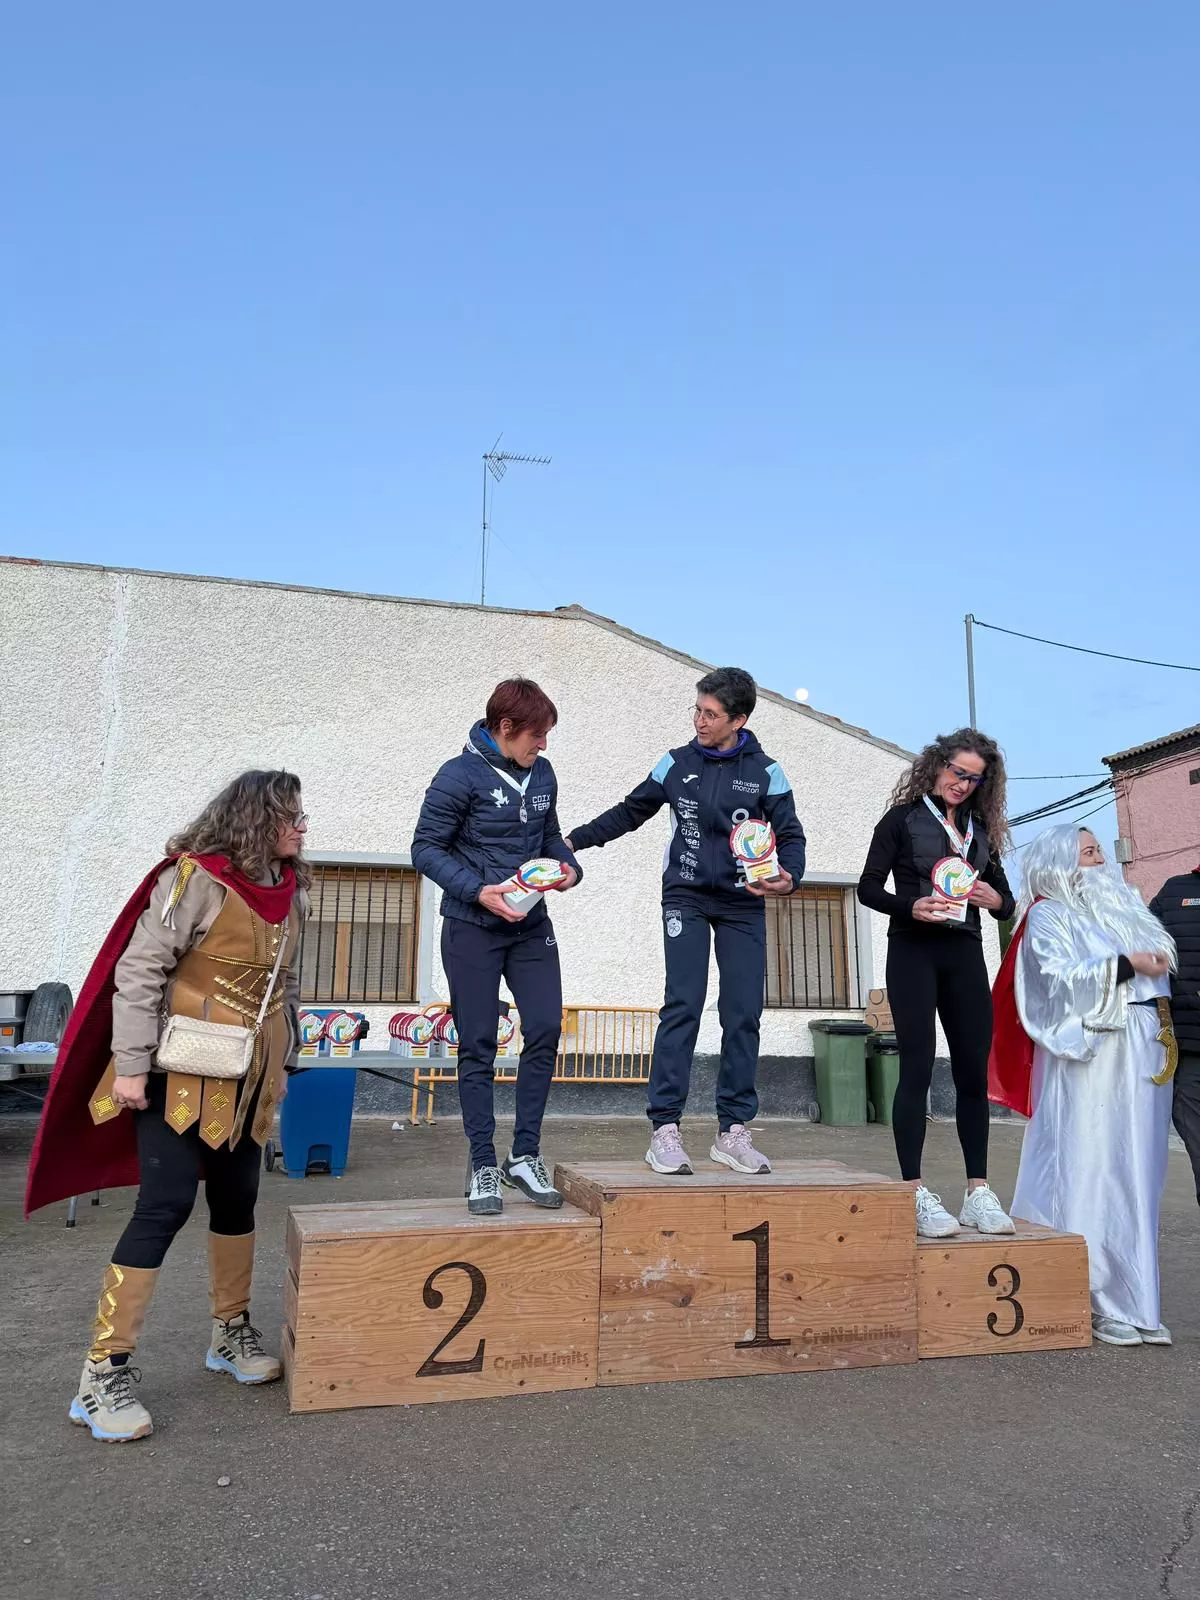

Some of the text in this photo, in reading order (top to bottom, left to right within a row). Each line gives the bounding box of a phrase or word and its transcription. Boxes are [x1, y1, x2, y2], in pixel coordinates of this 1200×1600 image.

[416, 1261, 487, 1378] 2
[733, 1220, 791, 1349] 1
[987, 1263, 1024, 1337] 3
